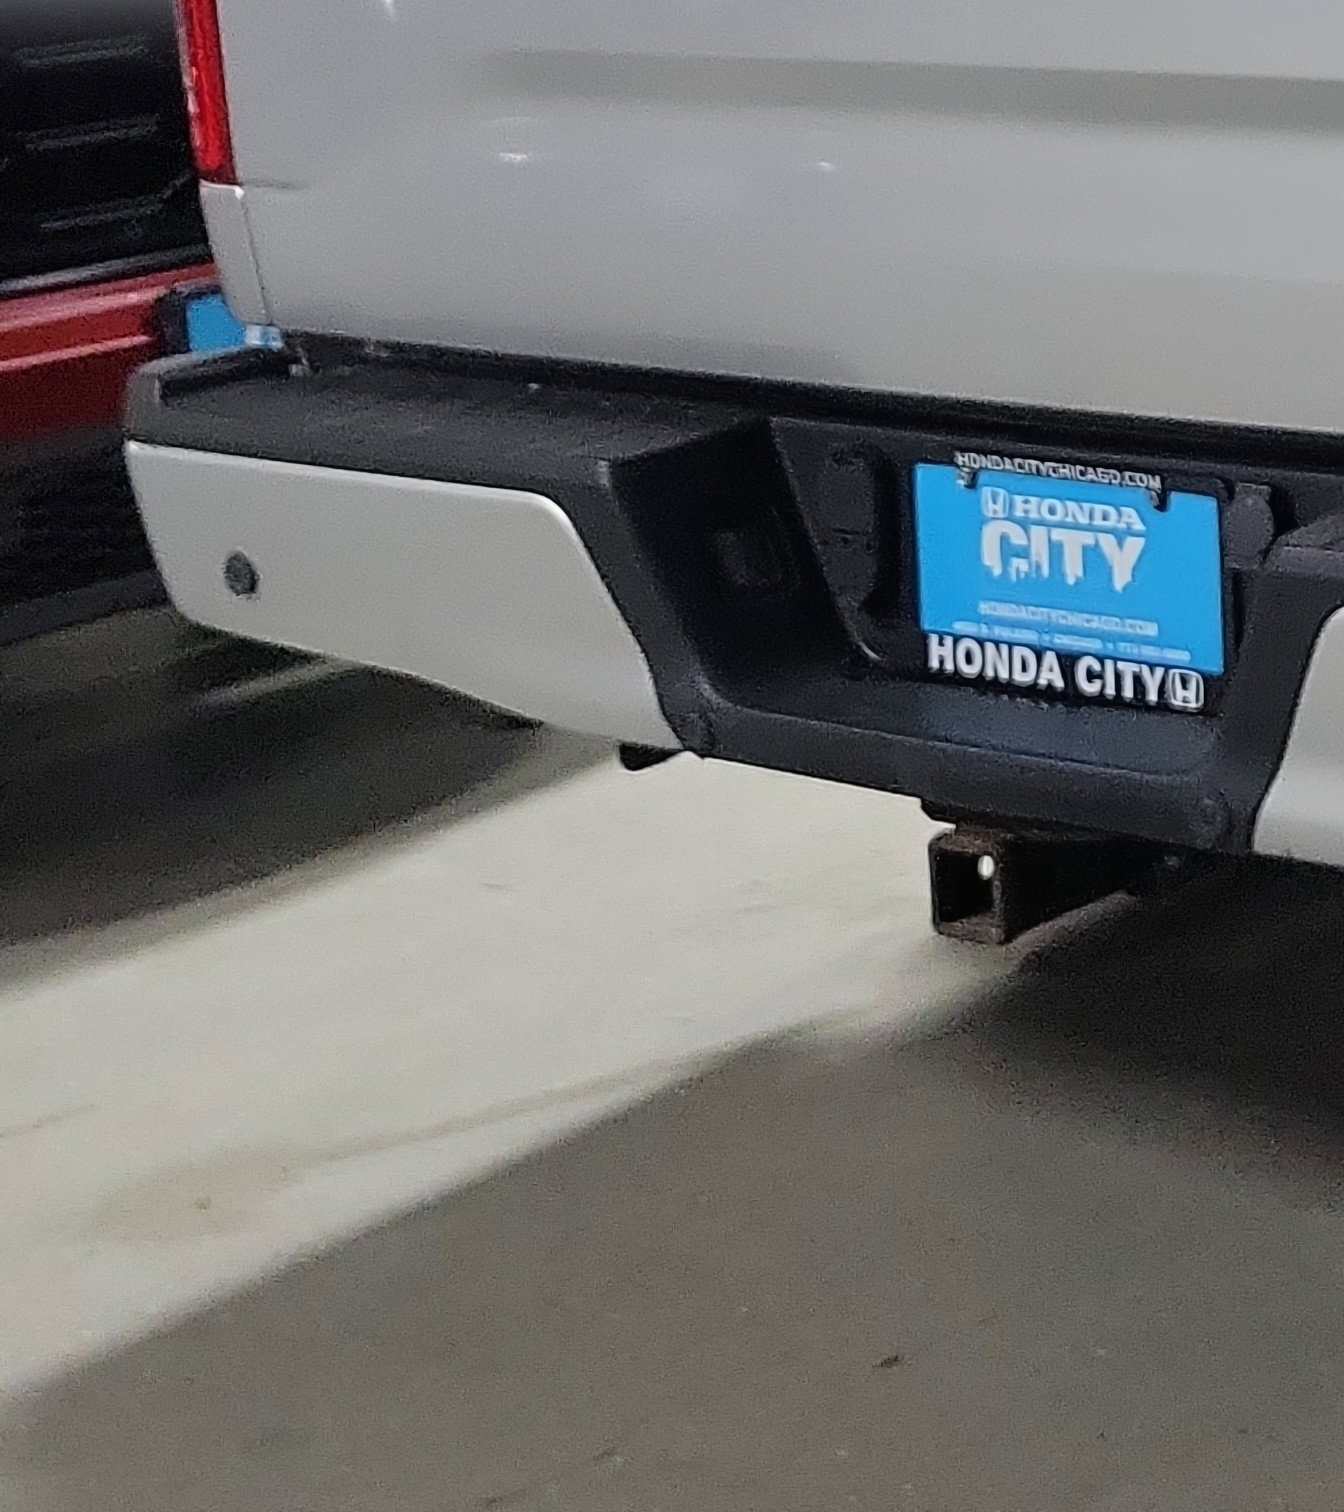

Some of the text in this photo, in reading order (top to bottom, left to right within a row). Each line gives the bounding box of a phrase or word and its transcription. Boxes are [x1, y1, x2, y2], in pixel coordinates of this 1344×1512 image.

[955, 451, 1161, 490] HONDACITYCHICAGO.COM
[1013, 493, 1147, 530] HONDA
[980, 520, 1147, 594] CITY
[927, 633, 1065, 691] HONDA
[1074, 656, 1165, 706] CITY
